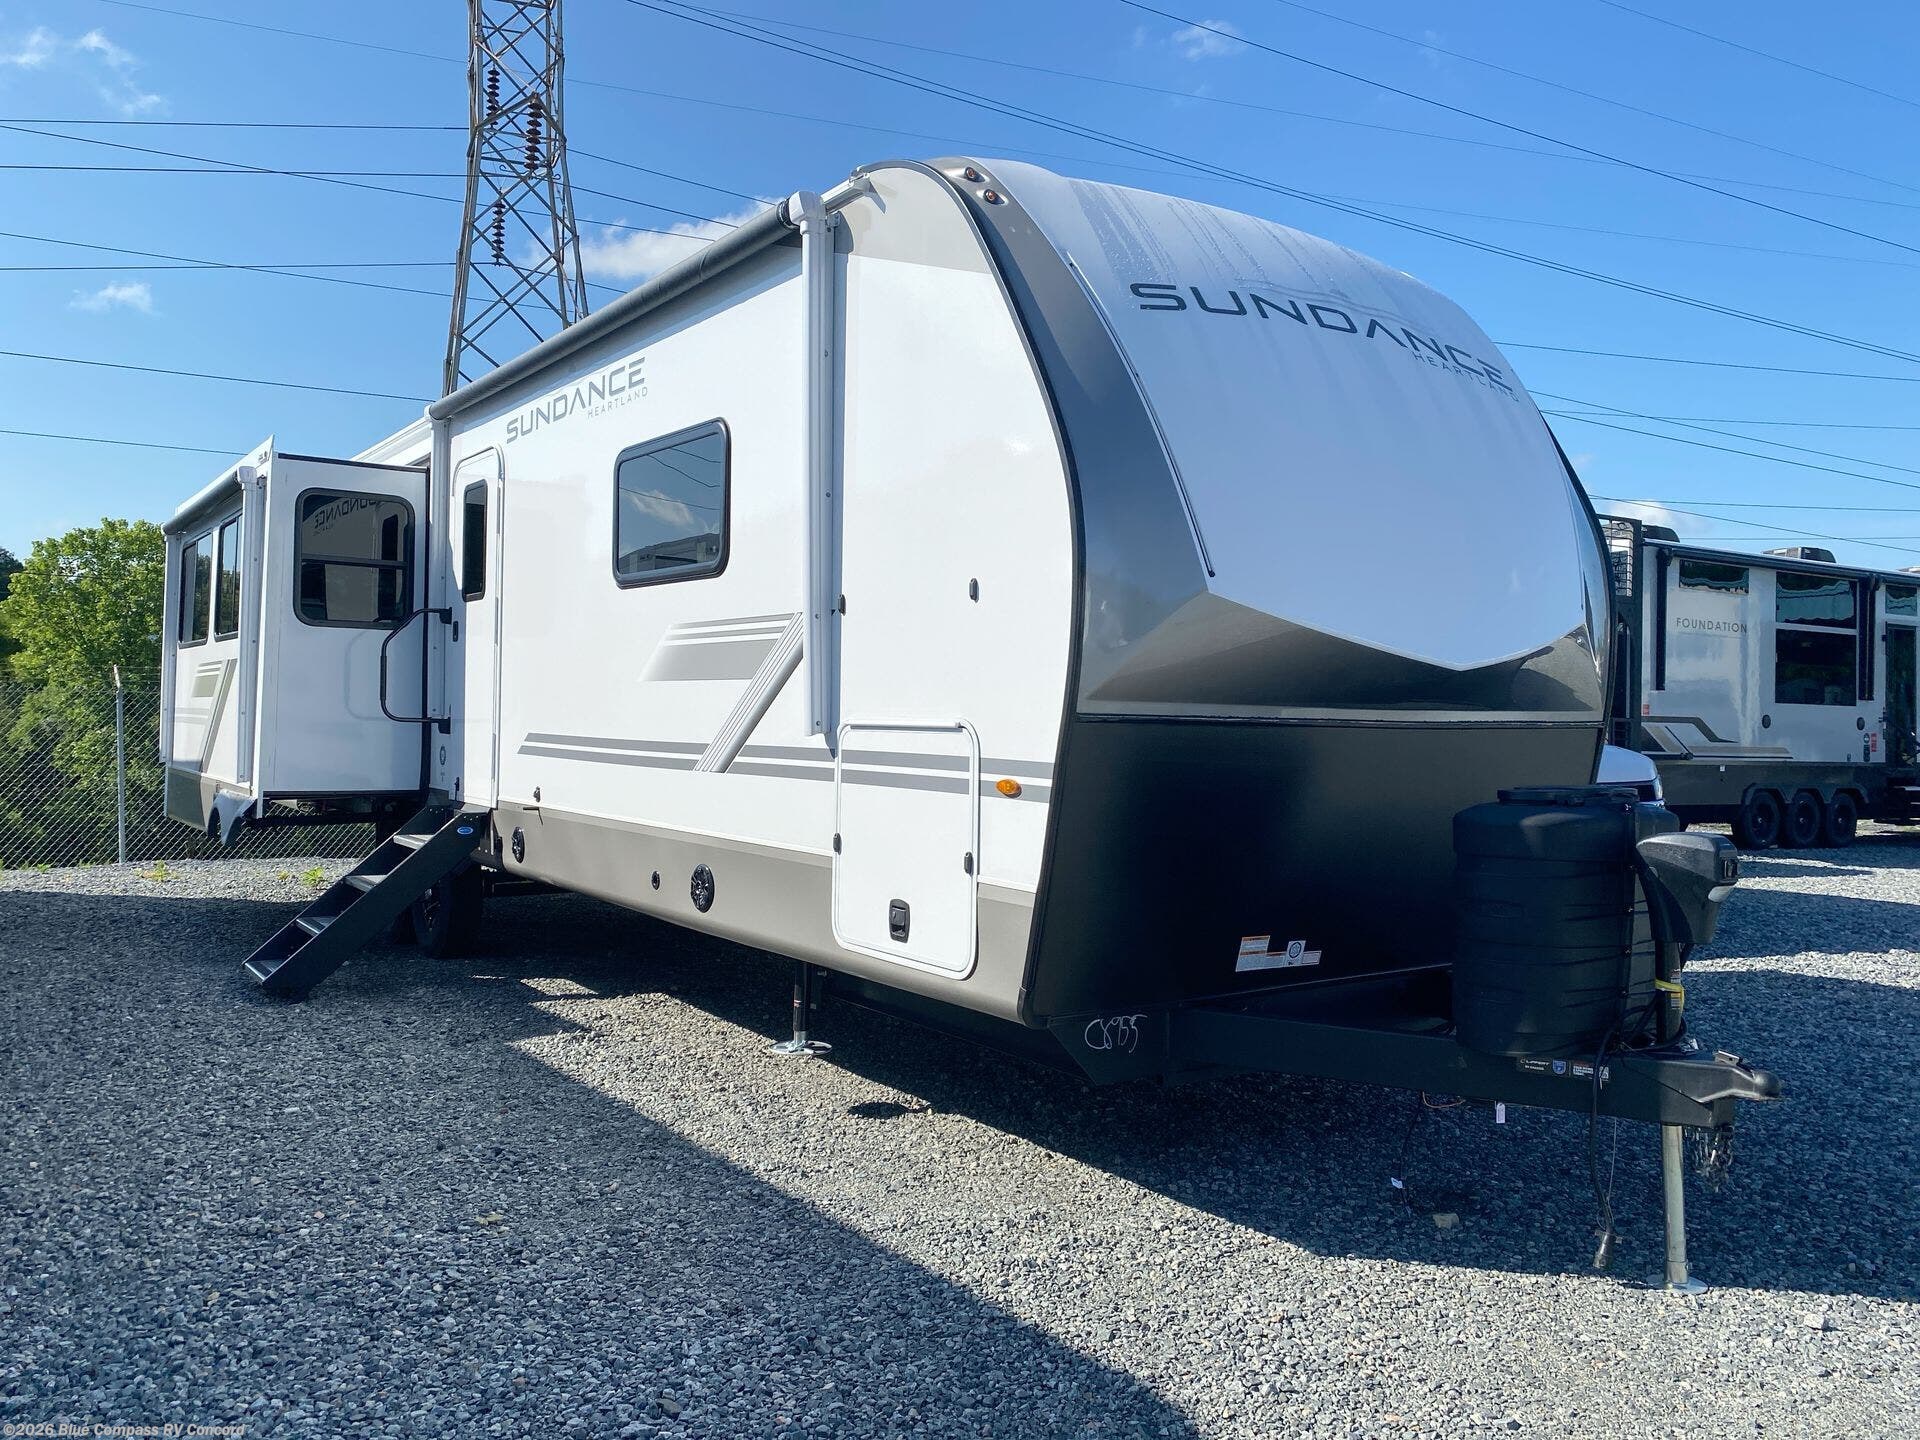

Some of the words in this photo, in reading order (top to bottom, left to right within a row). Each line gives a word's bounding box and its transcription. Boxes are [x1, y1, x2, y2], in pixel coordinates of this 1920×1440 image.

[1129, 282, 1513, 392] SUNDANCE
[506, 357, 646, 444] SUNDANCE
[587, 386, 649, 418] HEARTLAND
[1411, 351, 1520, 402] HEARTLAND
[1676, 617, 1748, 633] FOUNDATION
